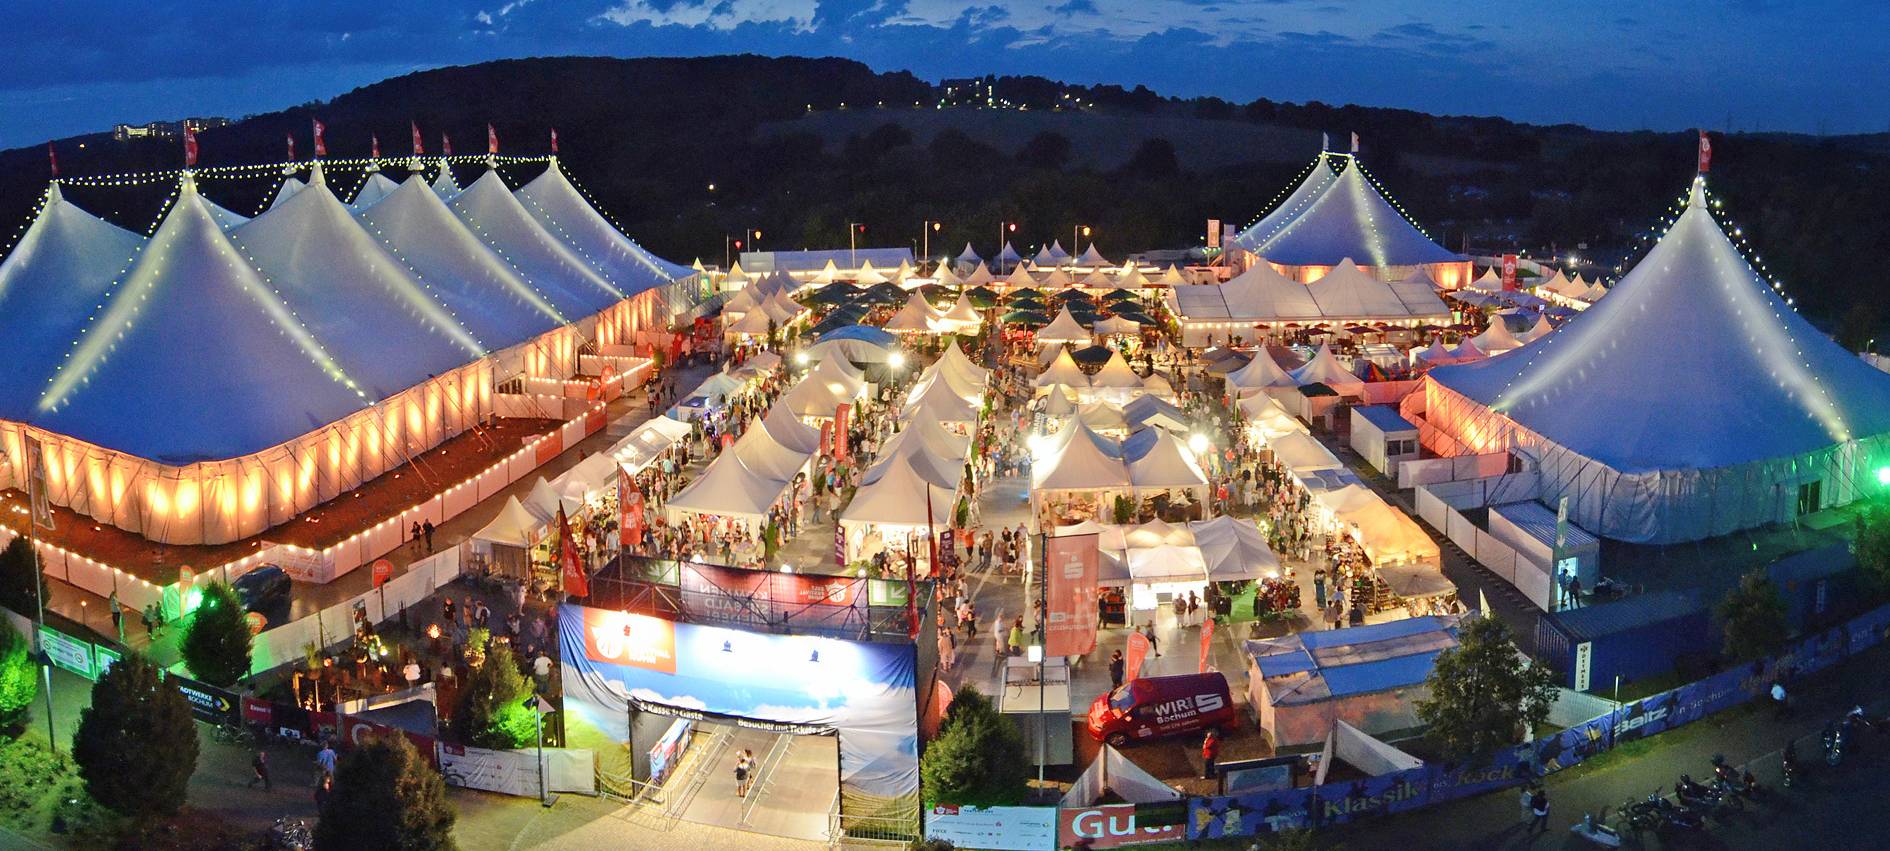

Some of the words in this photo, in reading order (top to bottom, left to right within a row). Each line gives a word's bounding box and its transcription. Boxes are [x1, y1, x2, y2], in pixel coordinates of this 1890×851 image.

[178, 685, 212, 701] ADTWERKE
[187, 695, 214, 708] BOCHUM
[648, 702, 671, 716] Kasse
[1155, 698, 1189, 717] WIR
[1156, 709, 1197, 724] Bochum
[737, 718, 776, 732] Besucher
[1323, 782, 1419, 818] Klassik
[1072, 810, 1172, 839] Gu.
